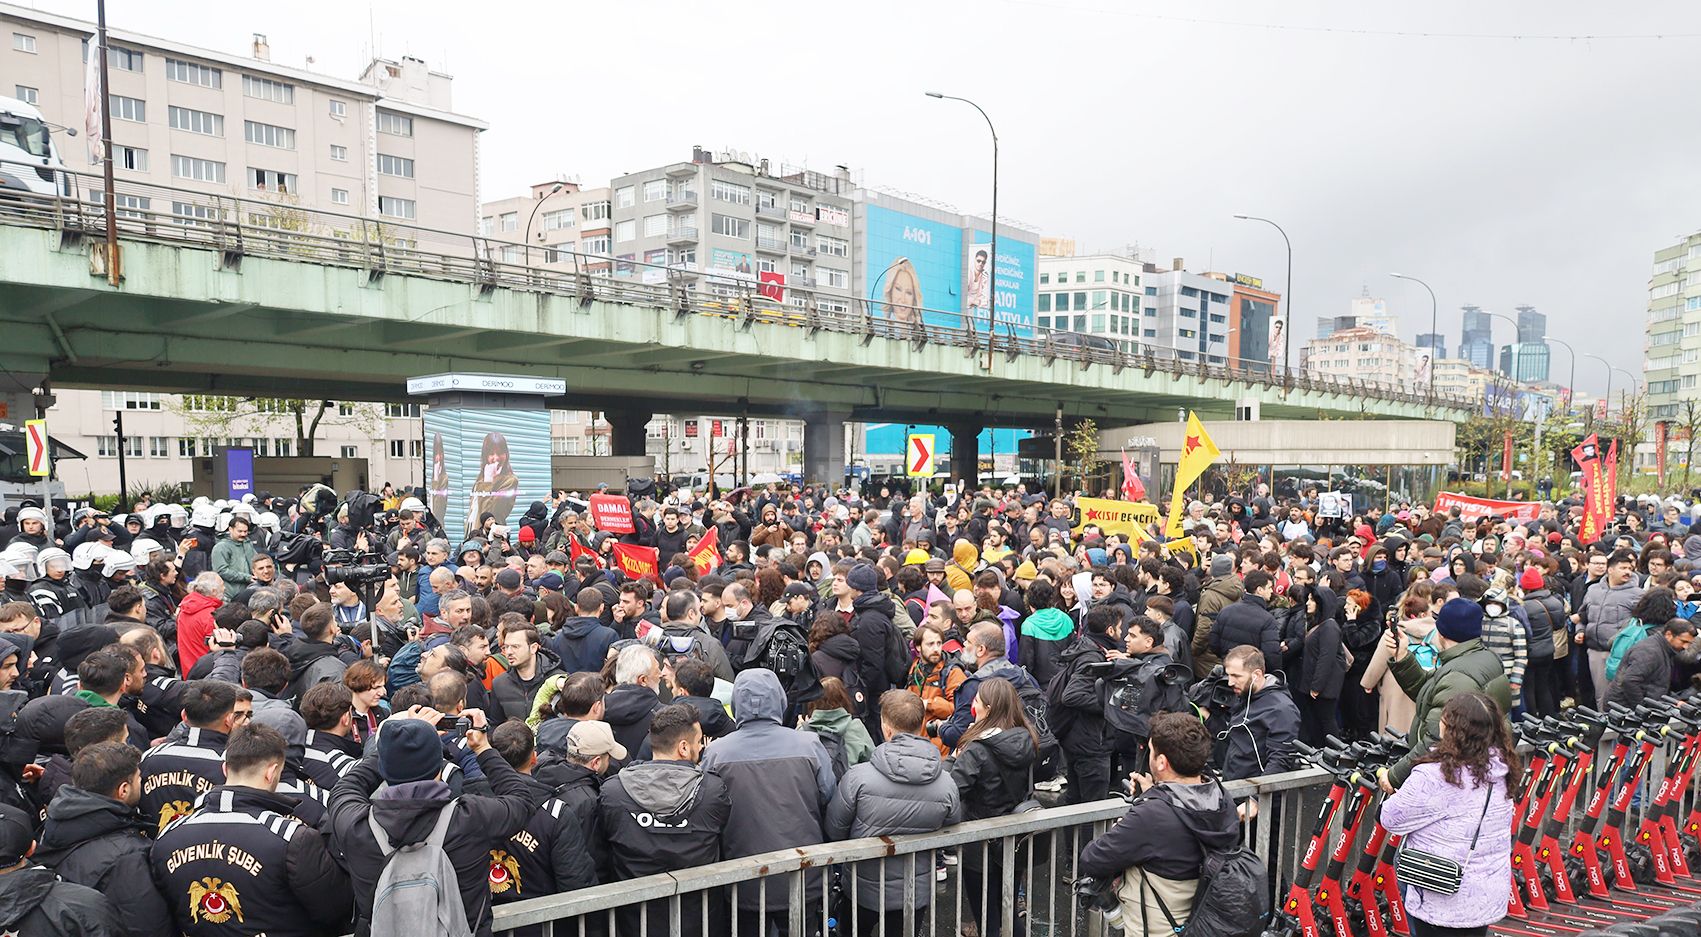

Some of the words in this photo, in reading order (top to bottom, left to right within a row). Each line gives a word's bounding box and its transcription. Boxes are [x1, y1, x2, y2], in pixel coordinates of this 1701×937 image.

[597, 503, 629, 514] DAMAL
[1439, 498, 1444, 507] 1
[144, 769, 195, 795] GÜVENLİK
[1655, 781, 1669, 801] hop
[1588, 791, 1600, 812] hop
[1615, 785, 1628, 806] hop
[1527, 801, 1539, 822] hop
[510, 830, 539, 853] UBE
[1333, 832, 1347, 856] hop
[166, 839, 225, 874] GÜVENLİK
[227, 846, 263, 877] ŞUBE
[1303, 840, 1317, 865] hop
[1671, 848, 1682, 866] hop
[1616, 859, 1626, 878] hop
[1656, 854, 1666, 873] hop
[1556, 872, 1566, 892] hop
[1590, 866, 1600, 886] hop
[1529, 878, 1539, 898] hop
[1368, 909, 1378, 931] hop
[1391, 900, 1402, 922] hop
[1305, 926, 1314, 937] ho
